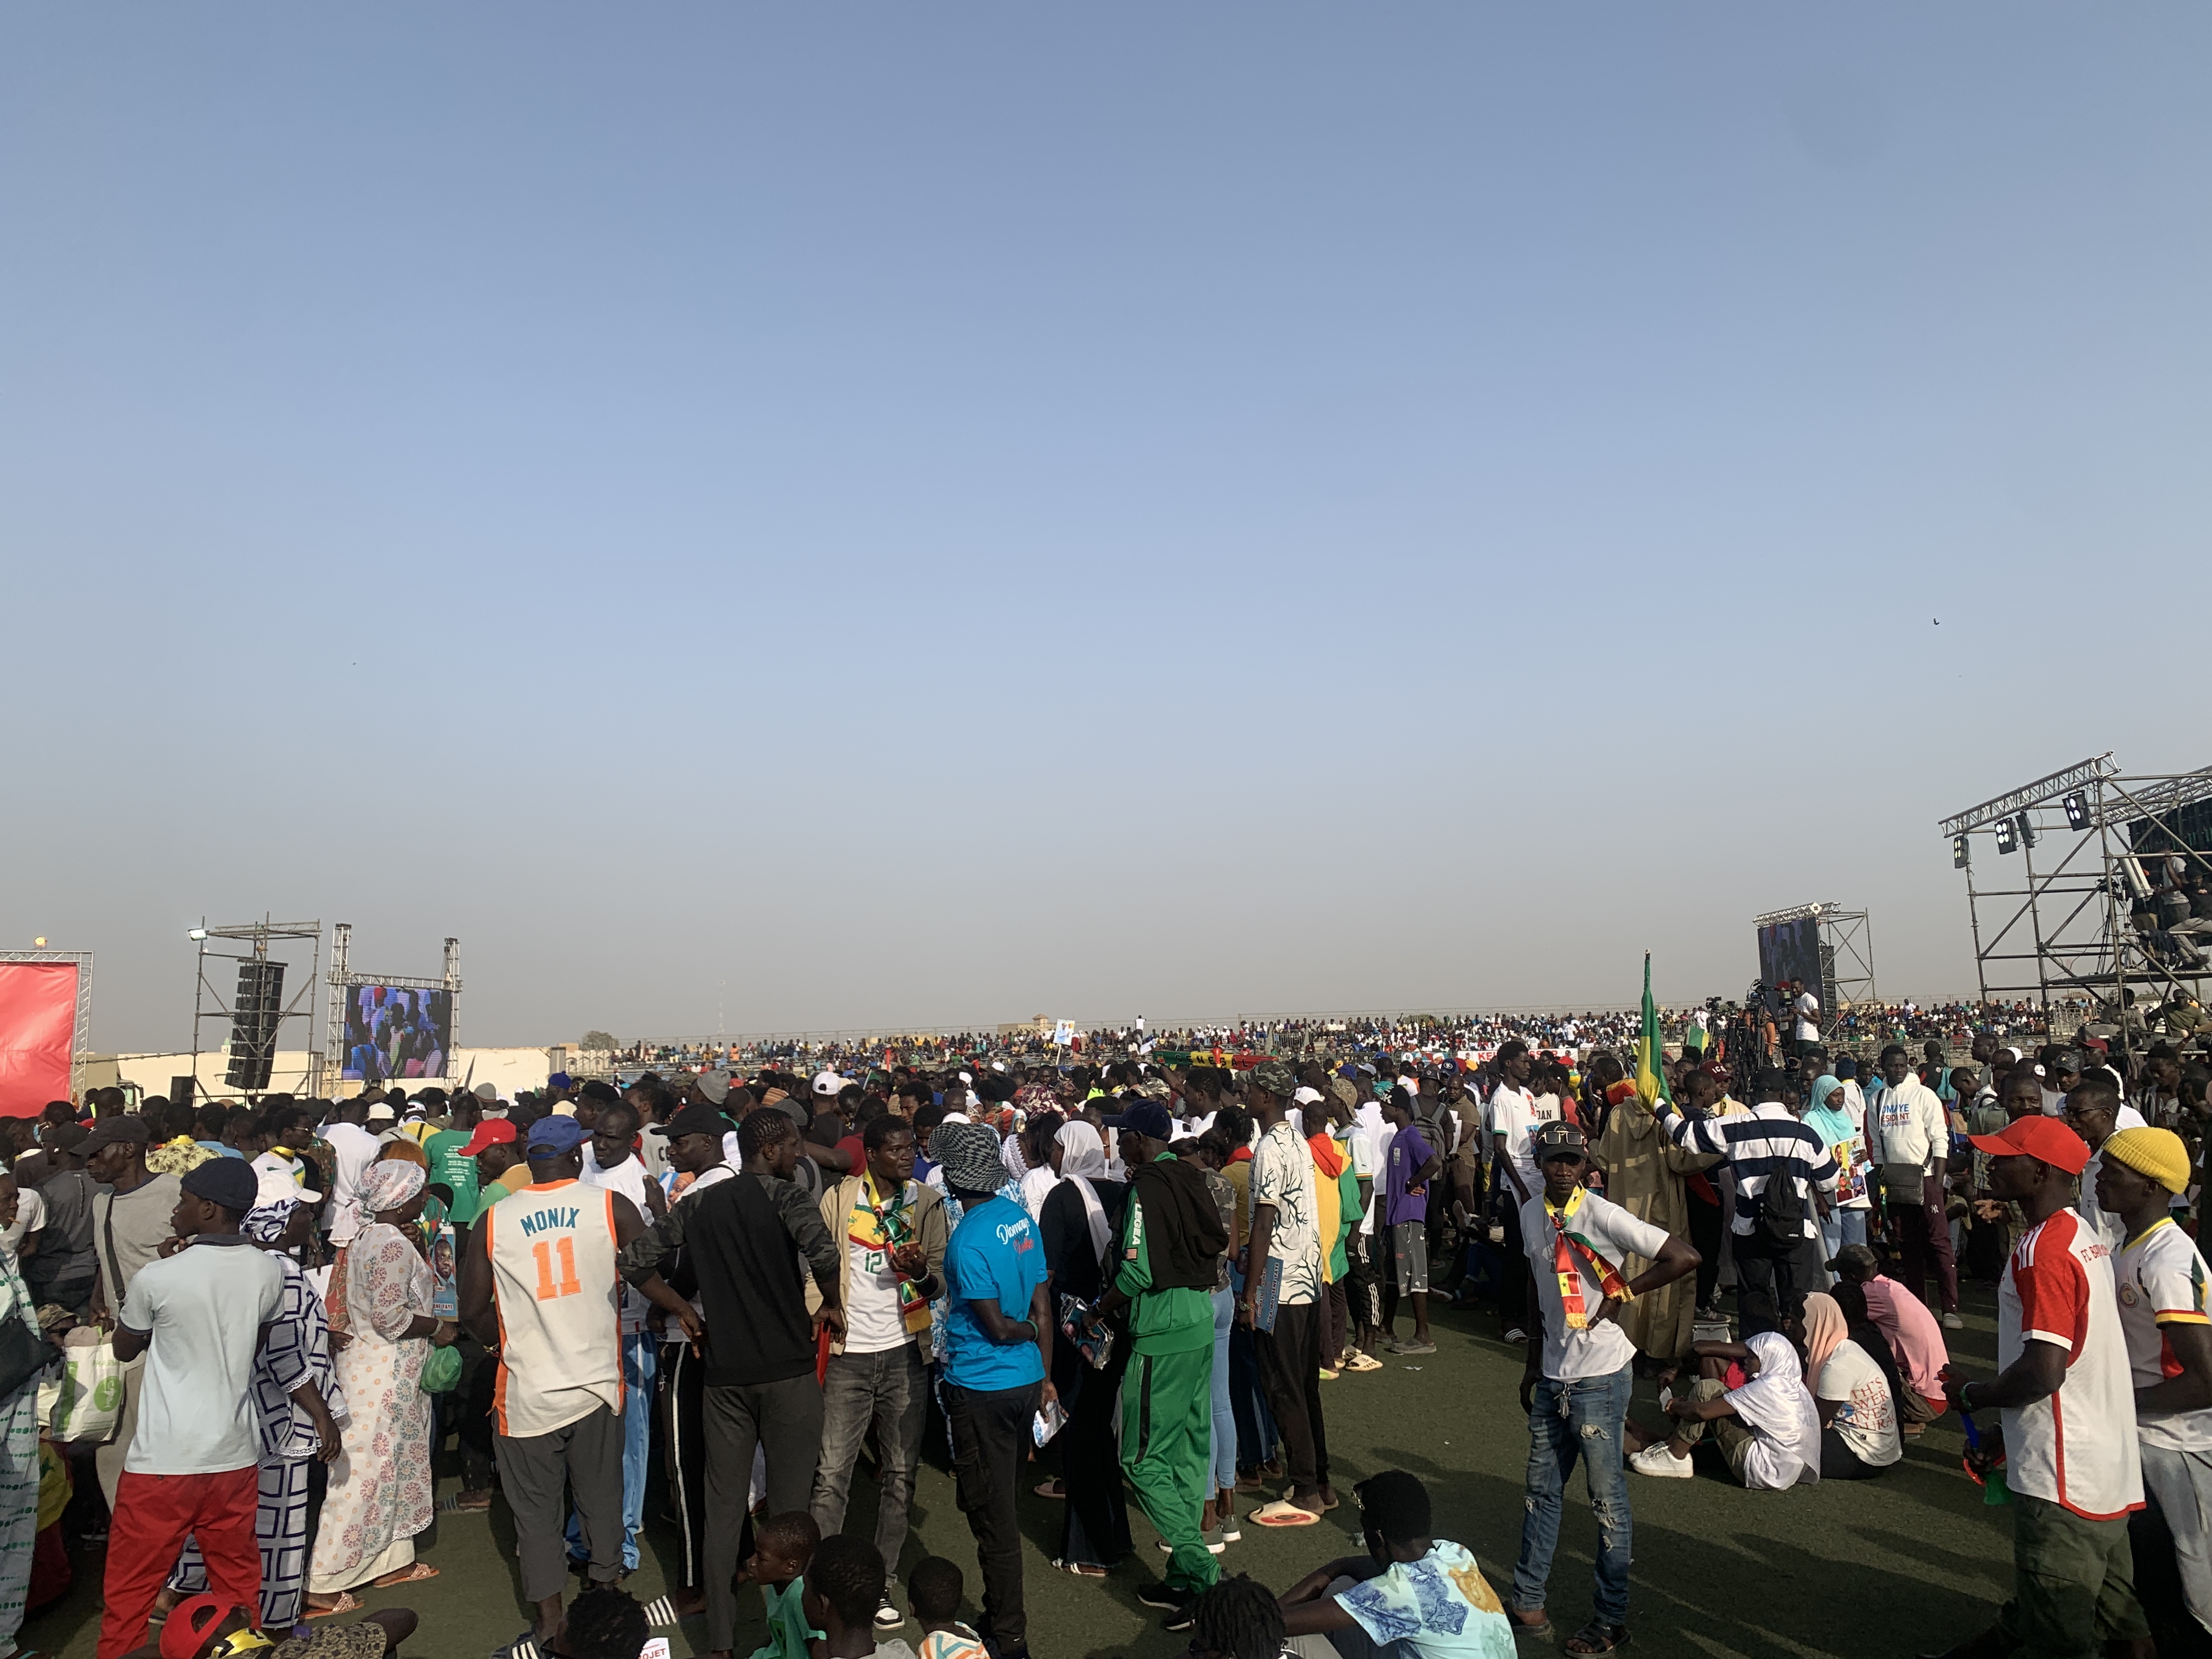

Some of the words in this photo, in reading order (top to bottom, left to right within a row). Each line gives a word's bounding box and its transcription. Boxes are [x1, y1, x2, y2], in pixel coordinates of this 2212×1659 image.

[1174, 1054, 1249, 1068] SENEGAL
[520, 1206, 580, 1238] MONIX
[1132, 1203, 1143, 1245] LEGEA
[533, 1236, 581, 1301] 11
[865, 1252, 882, 1275] 12
